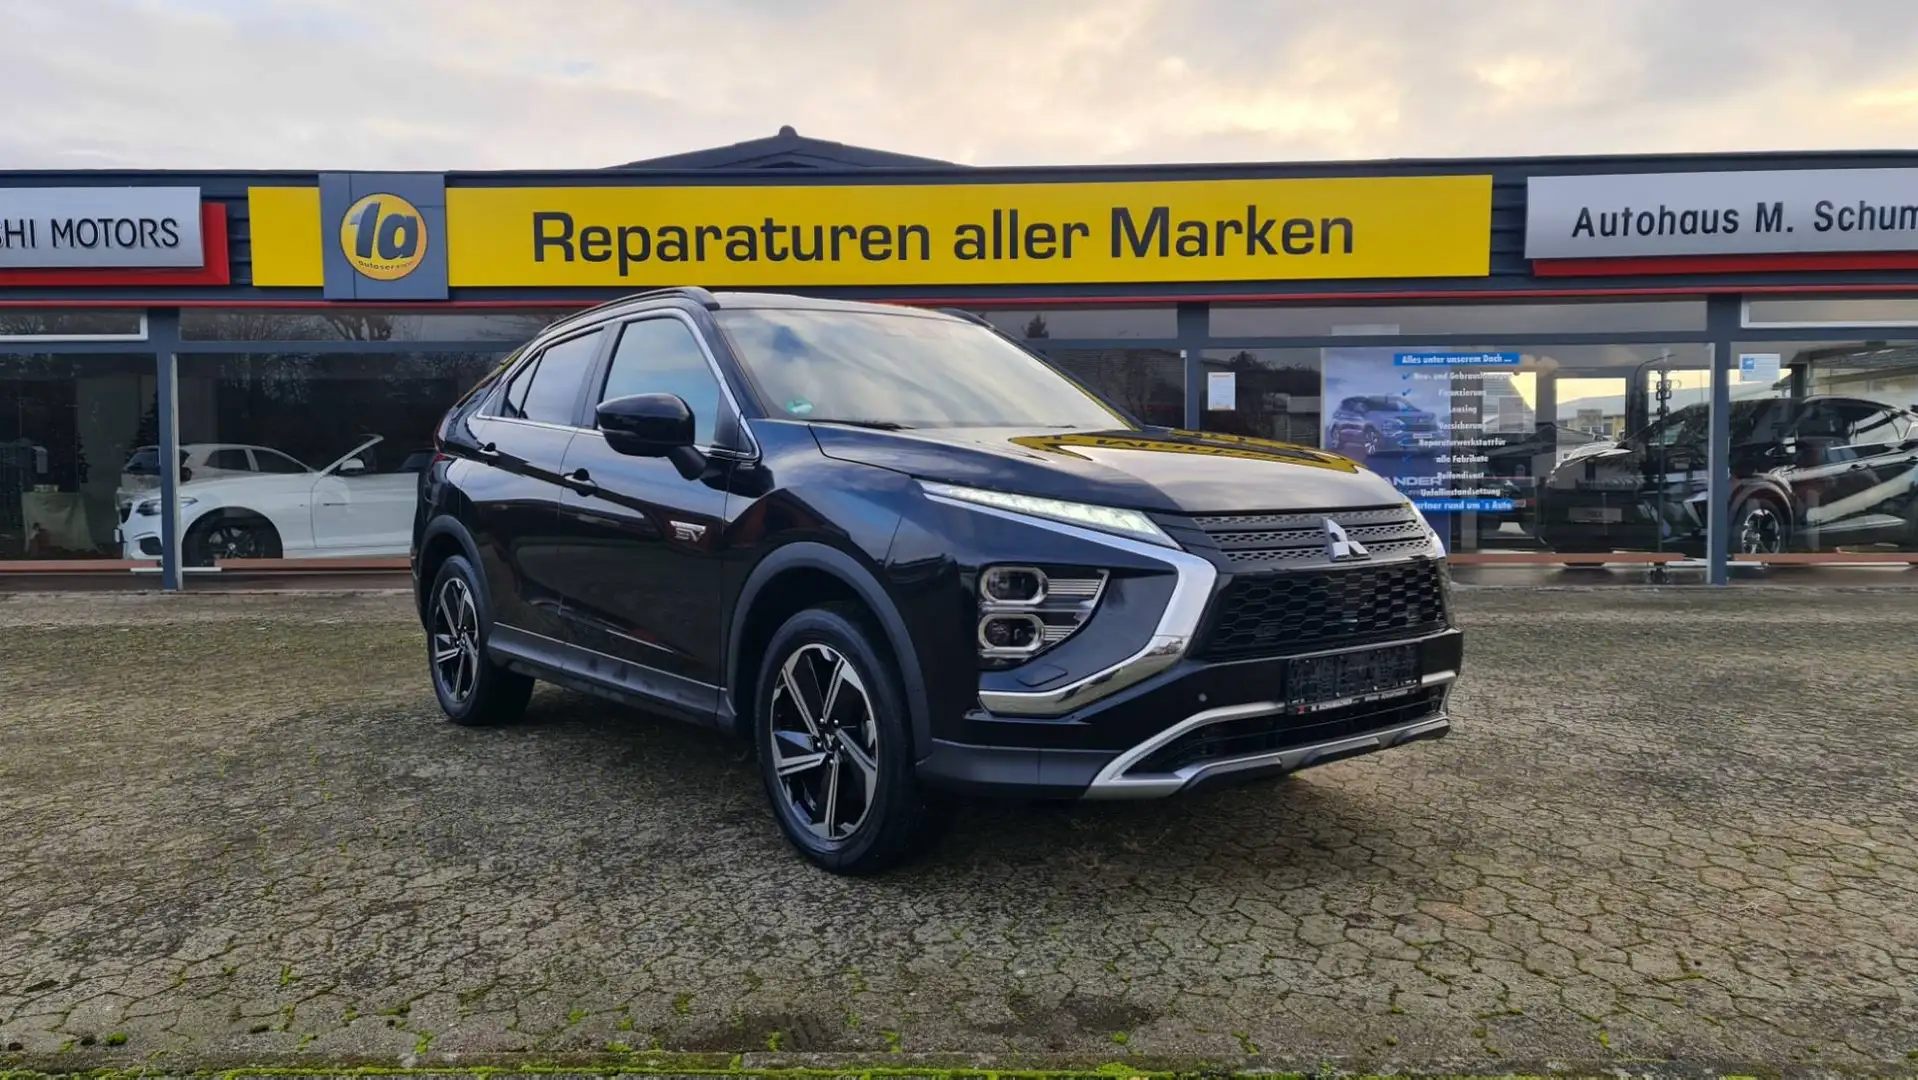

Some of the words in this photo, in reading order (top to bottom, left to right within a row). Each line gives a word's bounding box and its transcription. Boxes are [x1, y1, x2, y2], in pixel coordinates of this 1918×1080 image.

[1572, 205, 1739, 238] Autohaus
[1755, 202, 1794, 233] M.
[0, 219, 36, 248] HI
[51, 218, 179, 248] MOTORS
[350, 201, 419, 260] 1a
[533, 211, 930, 277] Reparaturen
[953, 208, 1090, 260] aller
[1111, 204, 1354, 258] Marken
[1402, 354, 1422, 364] Alles
[1423, 355, 1444, 364] unter
[1447, 355, 1481, 364] unserem
[1482, 353, 1502, 363] Dach
[1448, 404, 1478, 415] Leasing
[1439, 421, 1487, 432] Versicherung
[1436, 454, 1450, 463] alle
[1452, 454, 1488, 463] Fabrikate
[1444, 500, 1465, 510] rund
[1492, 499, 1512, 510] Auto
